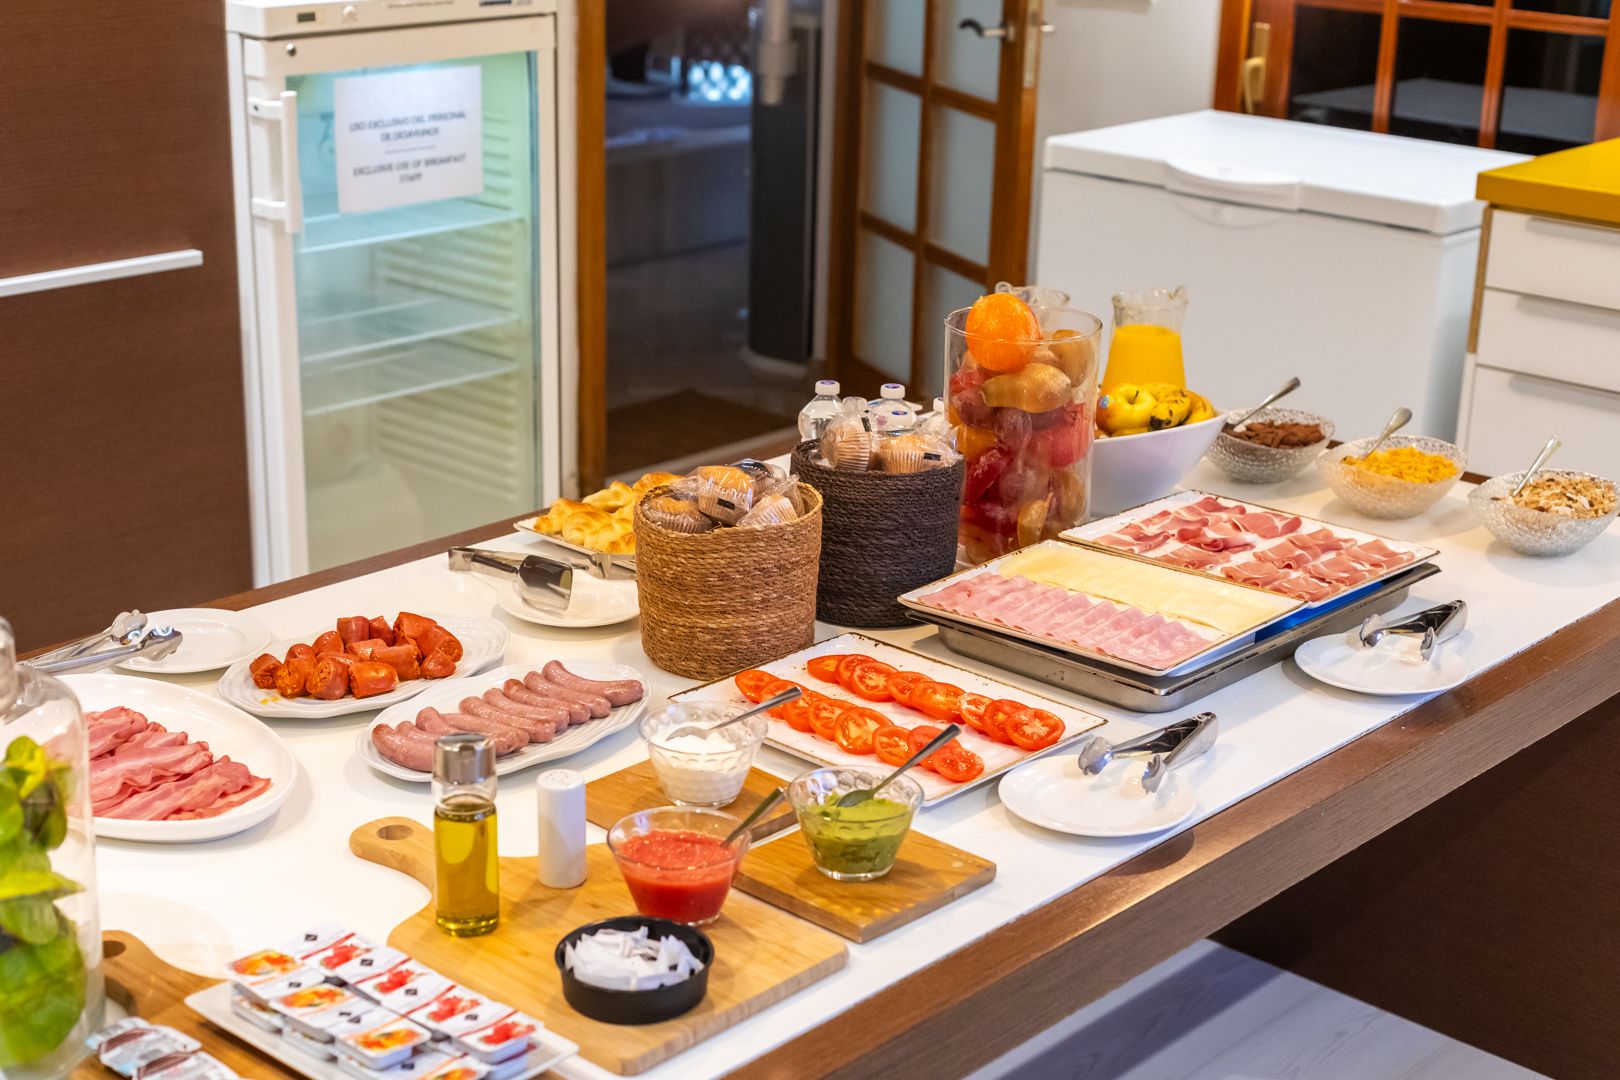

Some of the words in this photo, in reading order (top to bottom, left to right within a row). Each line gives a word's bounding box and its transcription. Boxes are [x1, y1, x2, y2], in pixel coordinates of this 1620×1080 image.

[427, 111, 466, 123] PERSONAL
[353, 164, 393, 177] EXCLUSIVE
[424, 153, 466, 167] BREAKFAST
